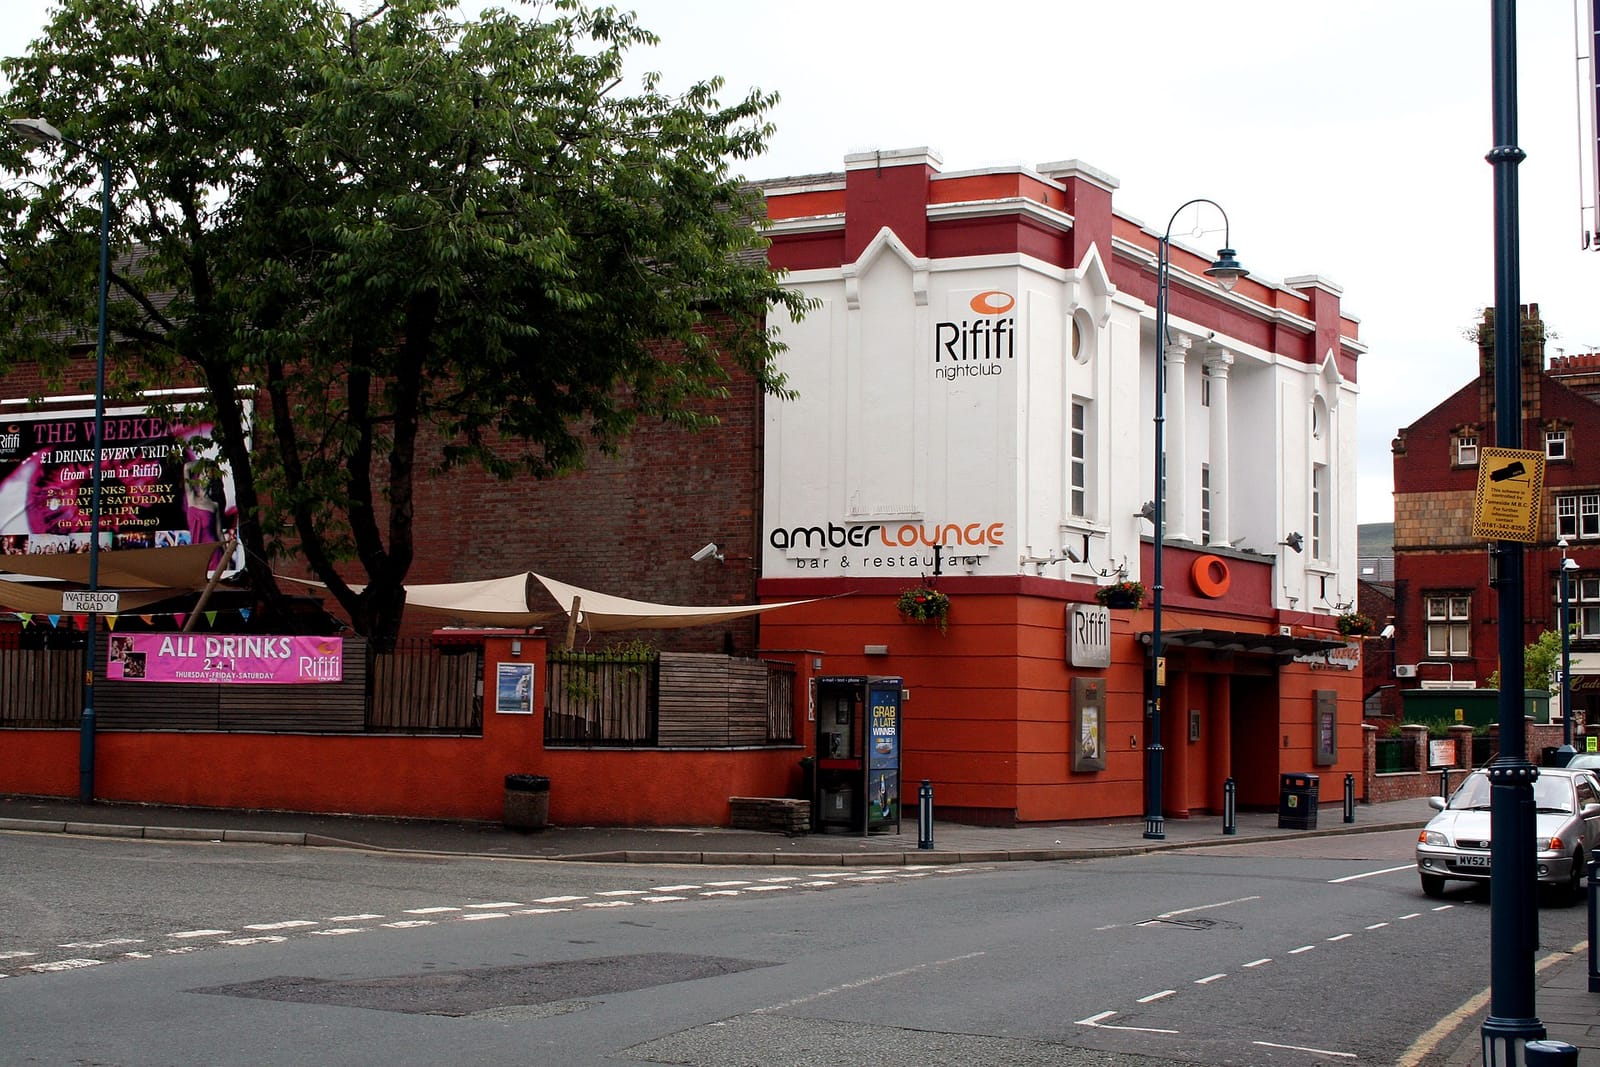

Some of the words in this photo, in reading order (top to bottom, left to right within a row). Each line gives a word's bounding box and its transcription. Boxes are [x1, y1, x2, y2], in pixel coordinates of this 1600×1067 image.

[935, 319, 1014, 362] Rififi
[935, 363, 1002, 380] nightclub
[33, 422, 77, 444] THE
[83, 416, 180, 442] WEEKEN
[40, 451, 52, 464] £1
[55, 448, 95, 463] DRINKS
[100, 446, 138, 461] EVERY
[60, 467, 85, 482] (from
[119, 465, 129, 478] in
[78, 485, 126, 496] DRNKS
[130, 483, 173, 494] EVERY
[106, 494, 175, 504] SATURDAY
[57, 518, 72, 528] (in
[75, 518, 112, 527] Amer
[115, 517, 160, 528] Lounge)
[796, 556, 829, 570] bar
[840, 556, 850, 568] &
[64, 593, 117, 602] WATERLOO
[76, 602, 104, 611] ROAD
[1075, 611, 1107, 646] Rififi
[158, 636, 198, 657] ALL
[205, 637, 292, 659] DRINKS
[203, 658, 236, 671] 2-4-1
[299, 656, 339, 677] Rififi
[873, 705, 896, 718] GRAB
[874, 718, 879, 728] A
[880, 718, 896, 727] LATE
[873, 727, 896, 736] WINNER
[1459, 856, 1484, 866] MV52
